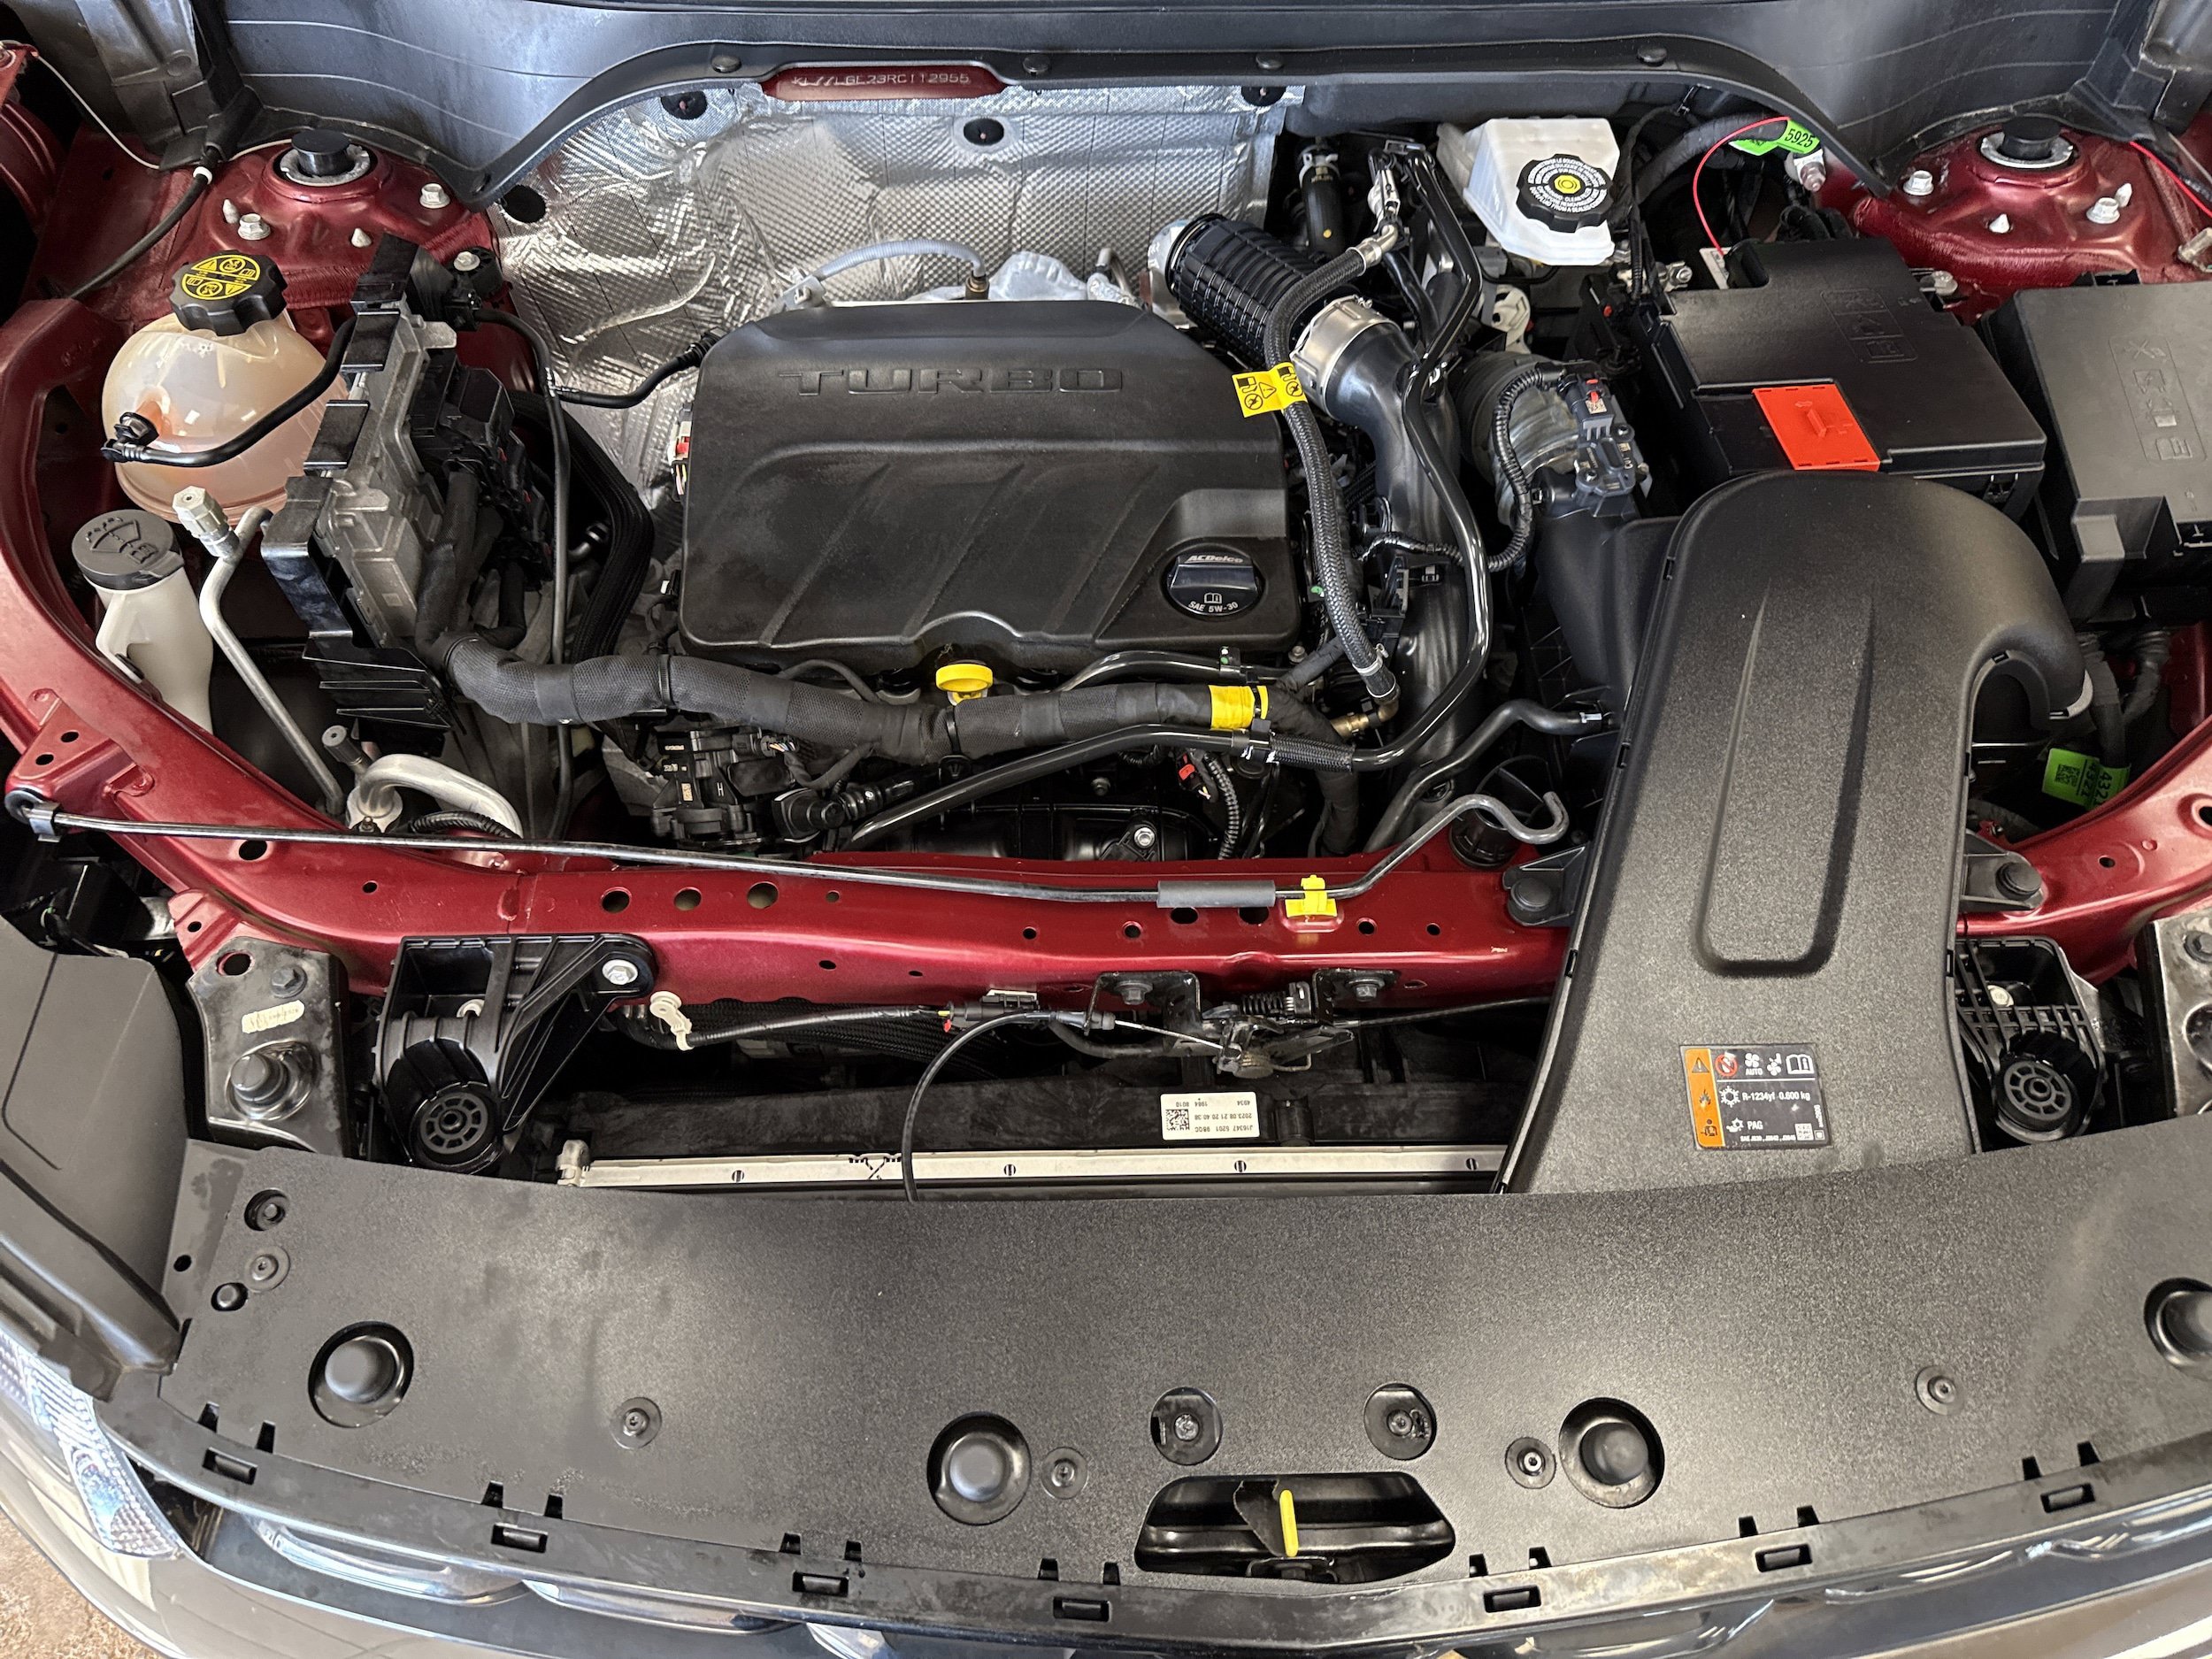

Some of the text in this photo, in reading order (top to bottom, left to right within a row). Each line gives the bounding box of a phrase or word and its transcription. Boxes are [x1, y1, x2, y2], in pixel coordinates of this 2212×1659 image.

[1785, 128, 1815, 148] 5925
[779, 368, 1123, 396] TURBO
[1185, 555, 1243, 564] ACDelco
[1188, 601, 1238, 612] SAE 5W-30
[1741, 1091, 1811, 1102] R-1234yf 0.600 kg
[1747, 1120, 1763, 1130] PAG
